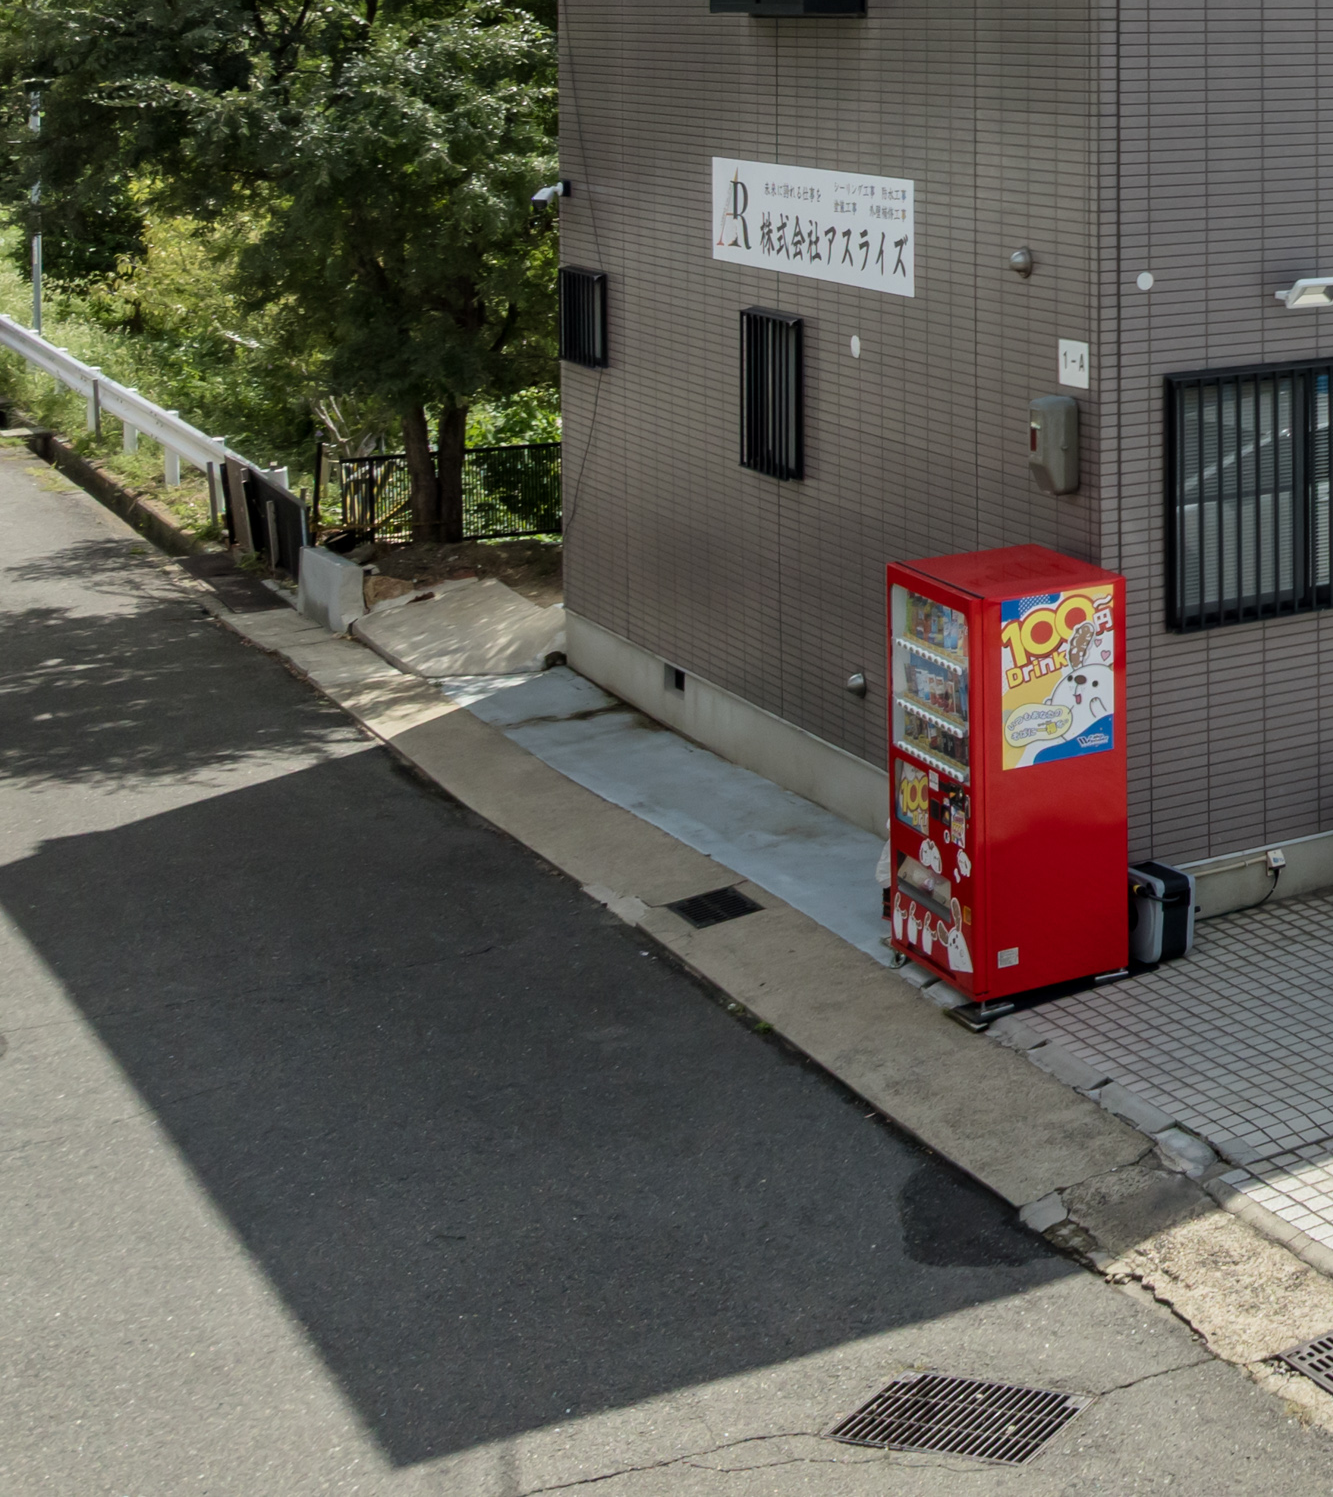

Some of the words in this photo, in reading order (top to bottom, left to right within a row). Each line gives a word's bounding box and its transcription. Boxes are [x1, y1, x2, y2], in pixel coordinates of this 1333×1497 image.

[759, 210, 909, 278] 株式会社アスライズ
[1063, 350, 1085, 372] 1-A
[1002, 593, 1096, 667] 100
[1006, 650, 1068, 689] Drink
[1007, 708, 1063, 731] いつもあなたの
